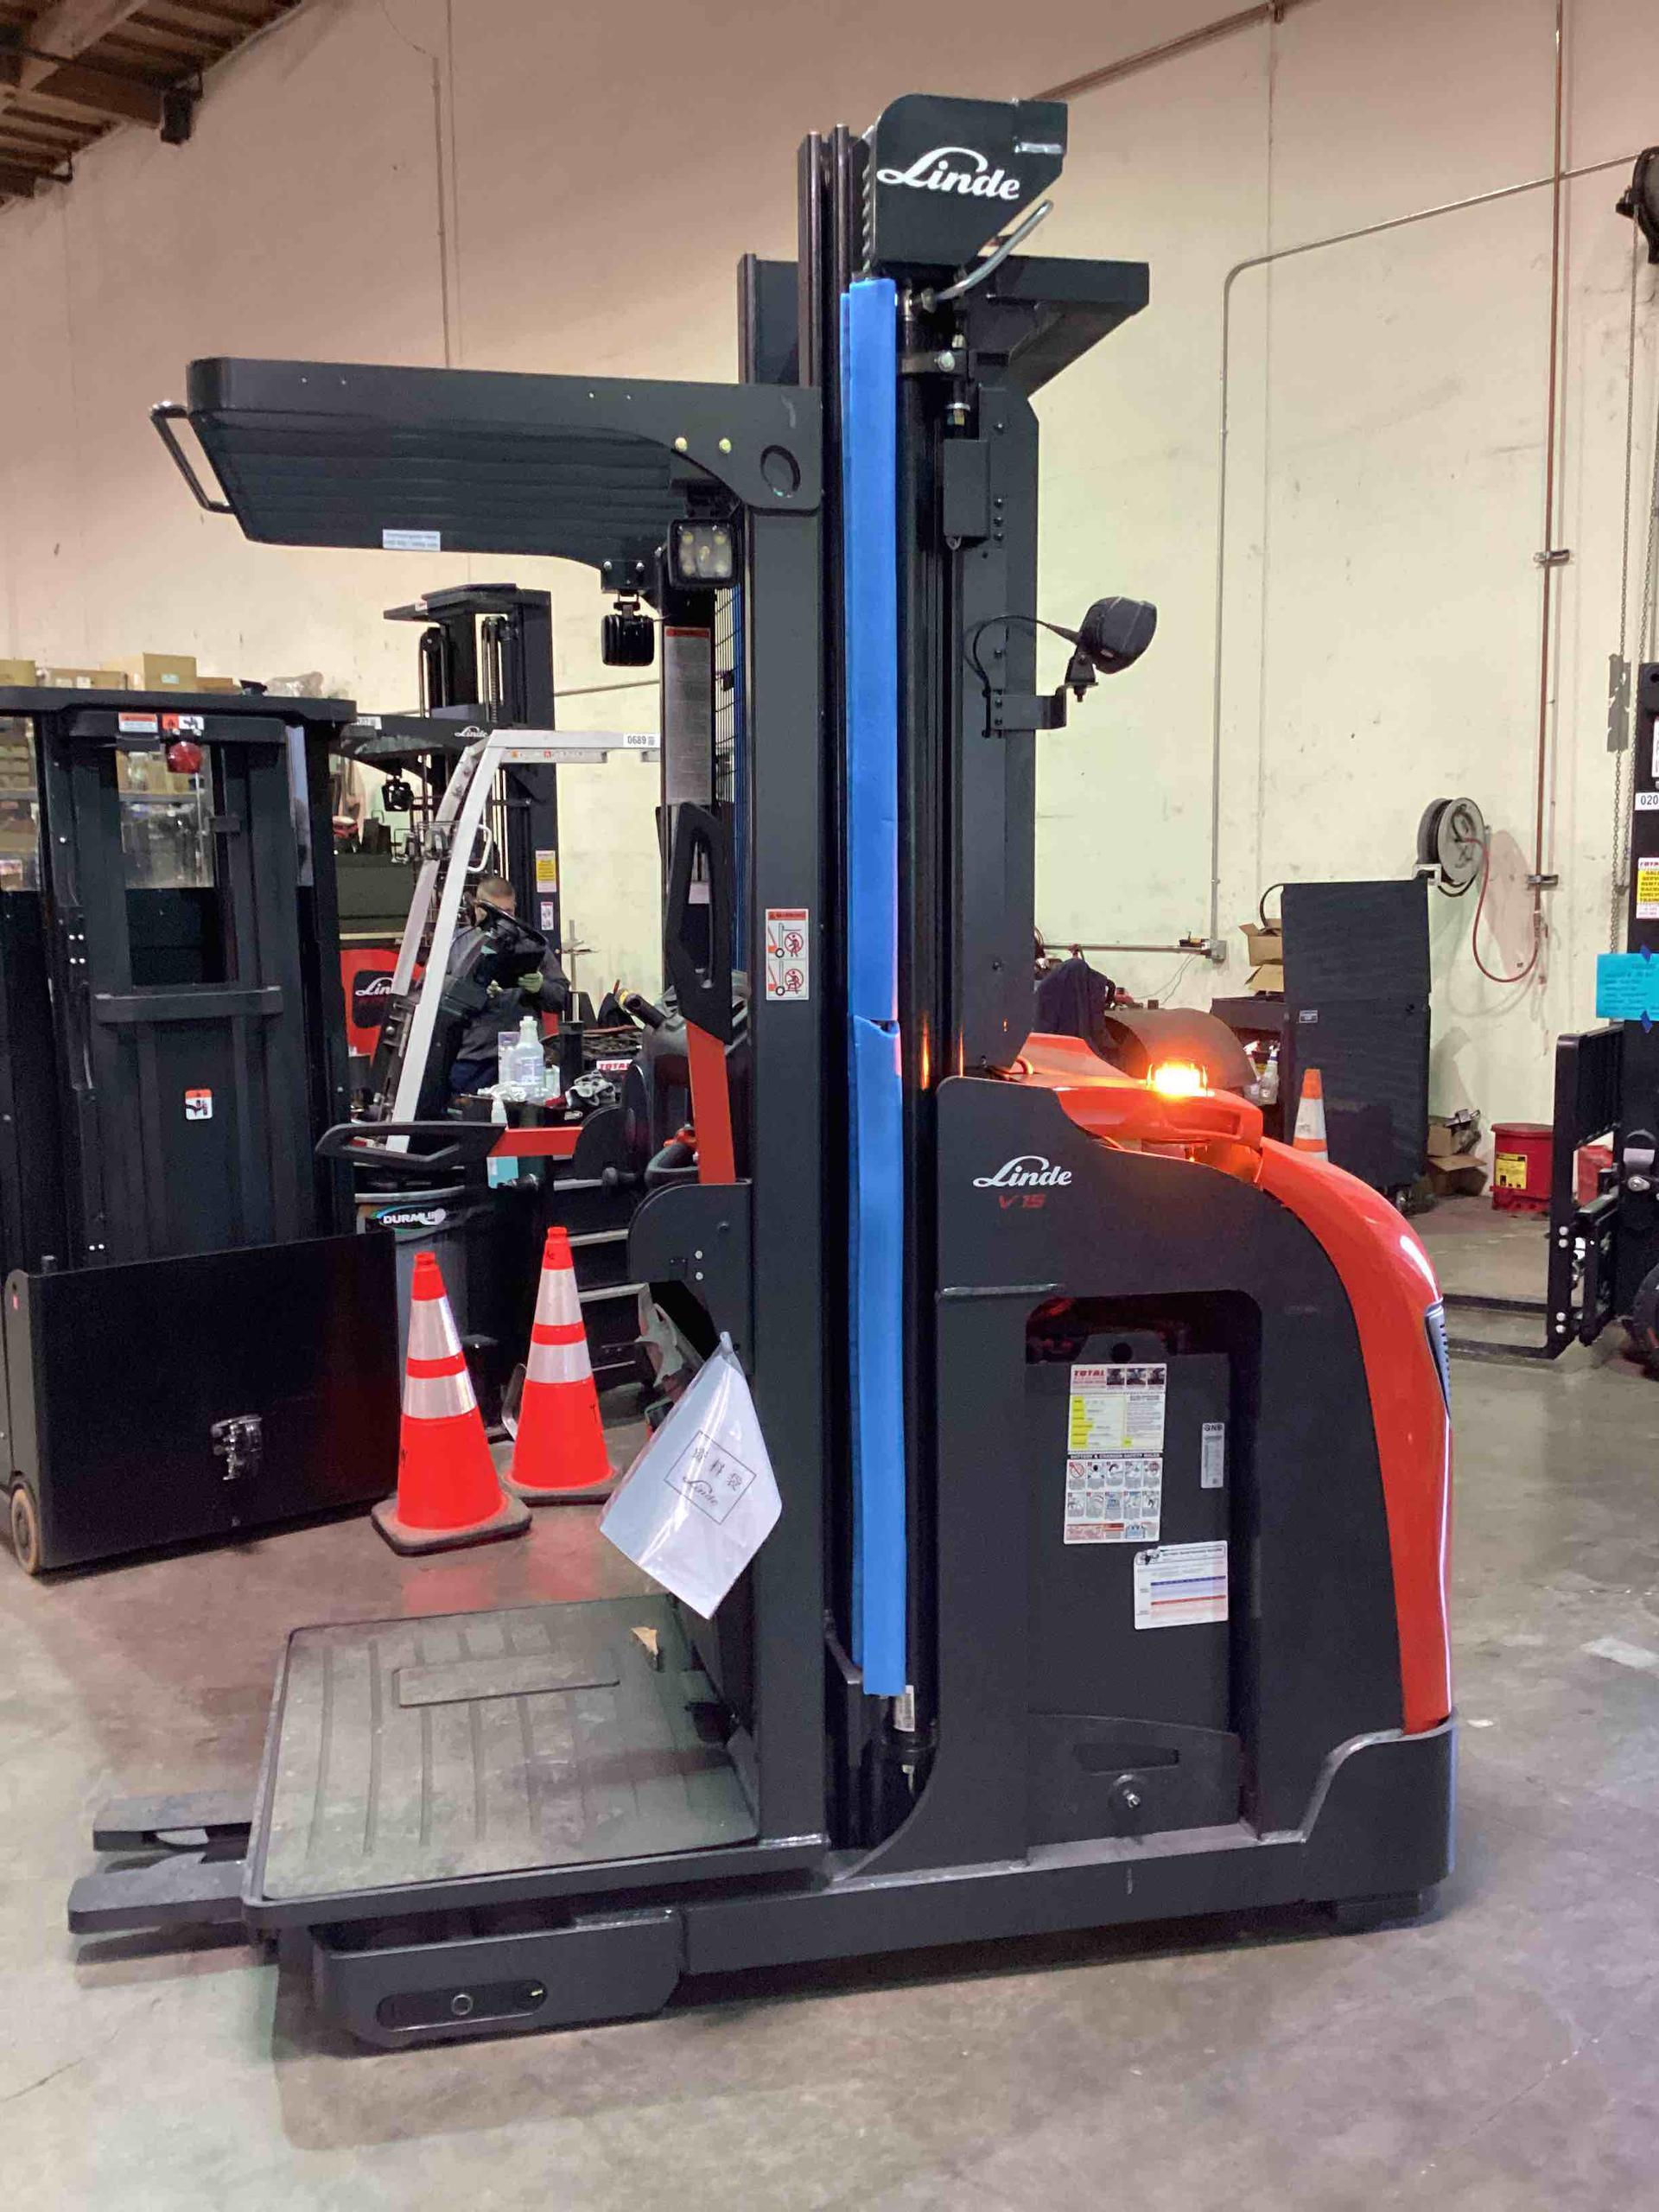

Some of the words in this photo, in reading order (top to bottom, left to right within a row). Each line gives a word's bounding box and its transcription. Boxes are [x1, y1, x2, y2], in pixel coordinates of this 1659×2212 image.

[876, 146, 1020, 200] Linde
[627, 735, 646, 744] 0689
[355, 976, 394, 995] Lin
[972, 1155, 1072, 1187] Linde
